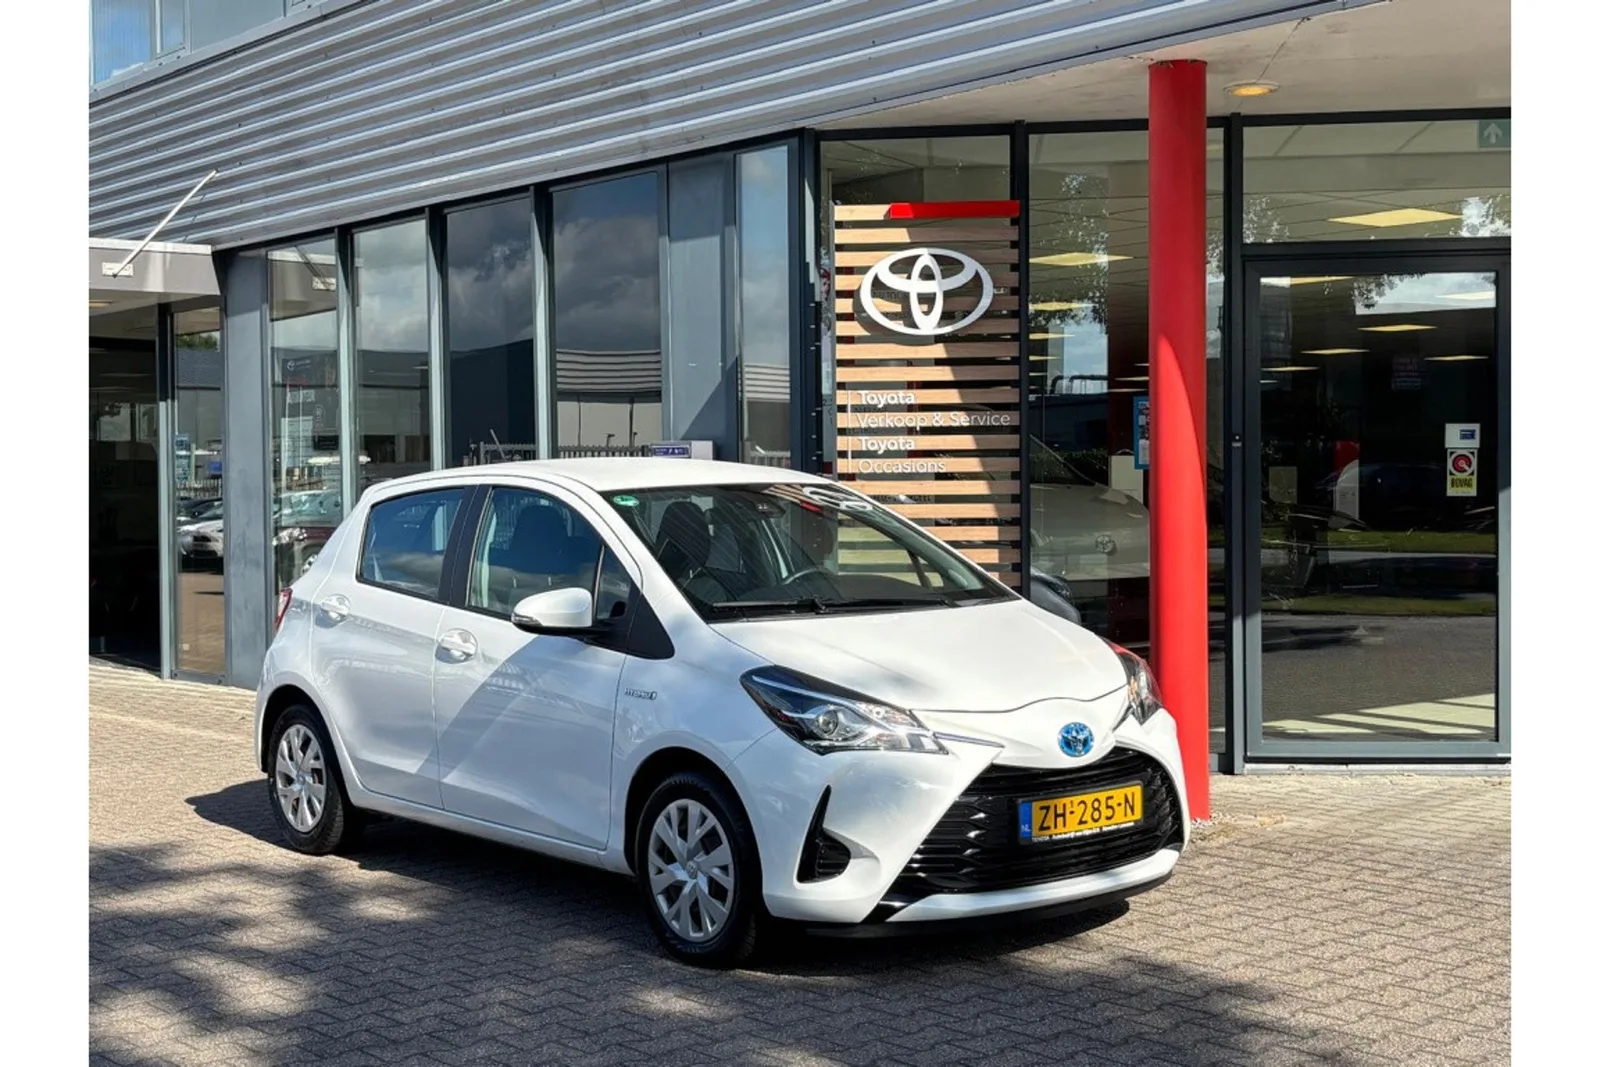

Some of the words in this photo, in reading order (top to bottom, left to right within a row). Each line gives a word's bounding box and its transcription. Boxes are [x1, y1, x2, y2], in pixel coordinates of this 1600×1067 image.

[858, 390, 915, 408] Toyota
[856, 412, 928, 431] Verkoop
[932, 412, 945, 426] &
[950, 411, 1011, 427] Service
[858, 436, 915, 454] Toyota
[858, 458, 947, 473] Occasions
[1451, 477, 1473, 488] BOVAG
[1038, 792, 1135, 832] ZH-285-N
